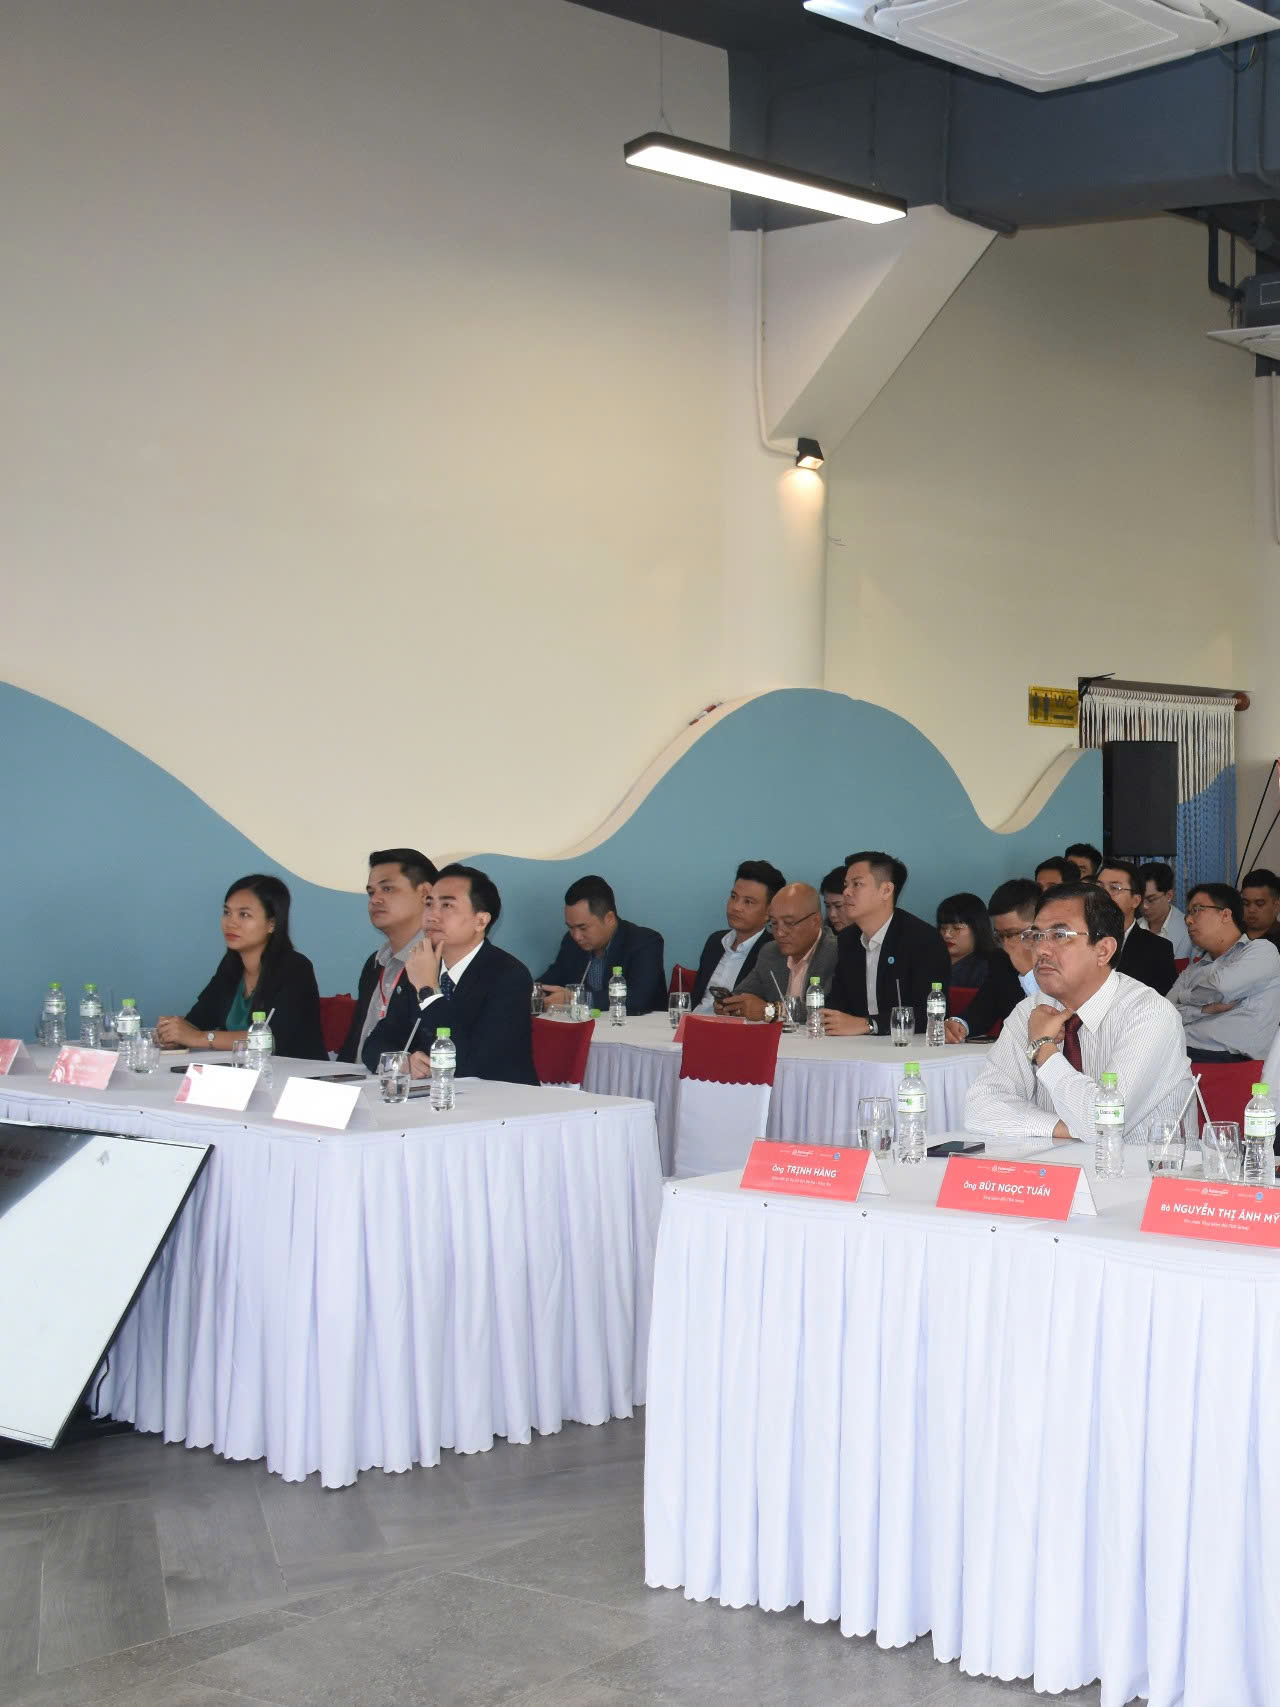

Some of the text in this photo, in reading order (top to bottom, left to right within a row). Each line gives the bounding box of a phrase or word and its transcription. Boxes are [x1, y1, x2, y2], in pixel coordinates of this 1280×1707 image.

[1054, 694, 1074, 710] WC
[787, 1165, 811, 1176] TRỊNH
[964, 1180, 1050, 1196] Ông BÙI NGỌC TUẤN
[1173, 1203, 1215, 1216] NGUYỄN
[1218, 1208, 1237, 1221] THỊ
[1264, 1211, 1280, 1224] MỸ
